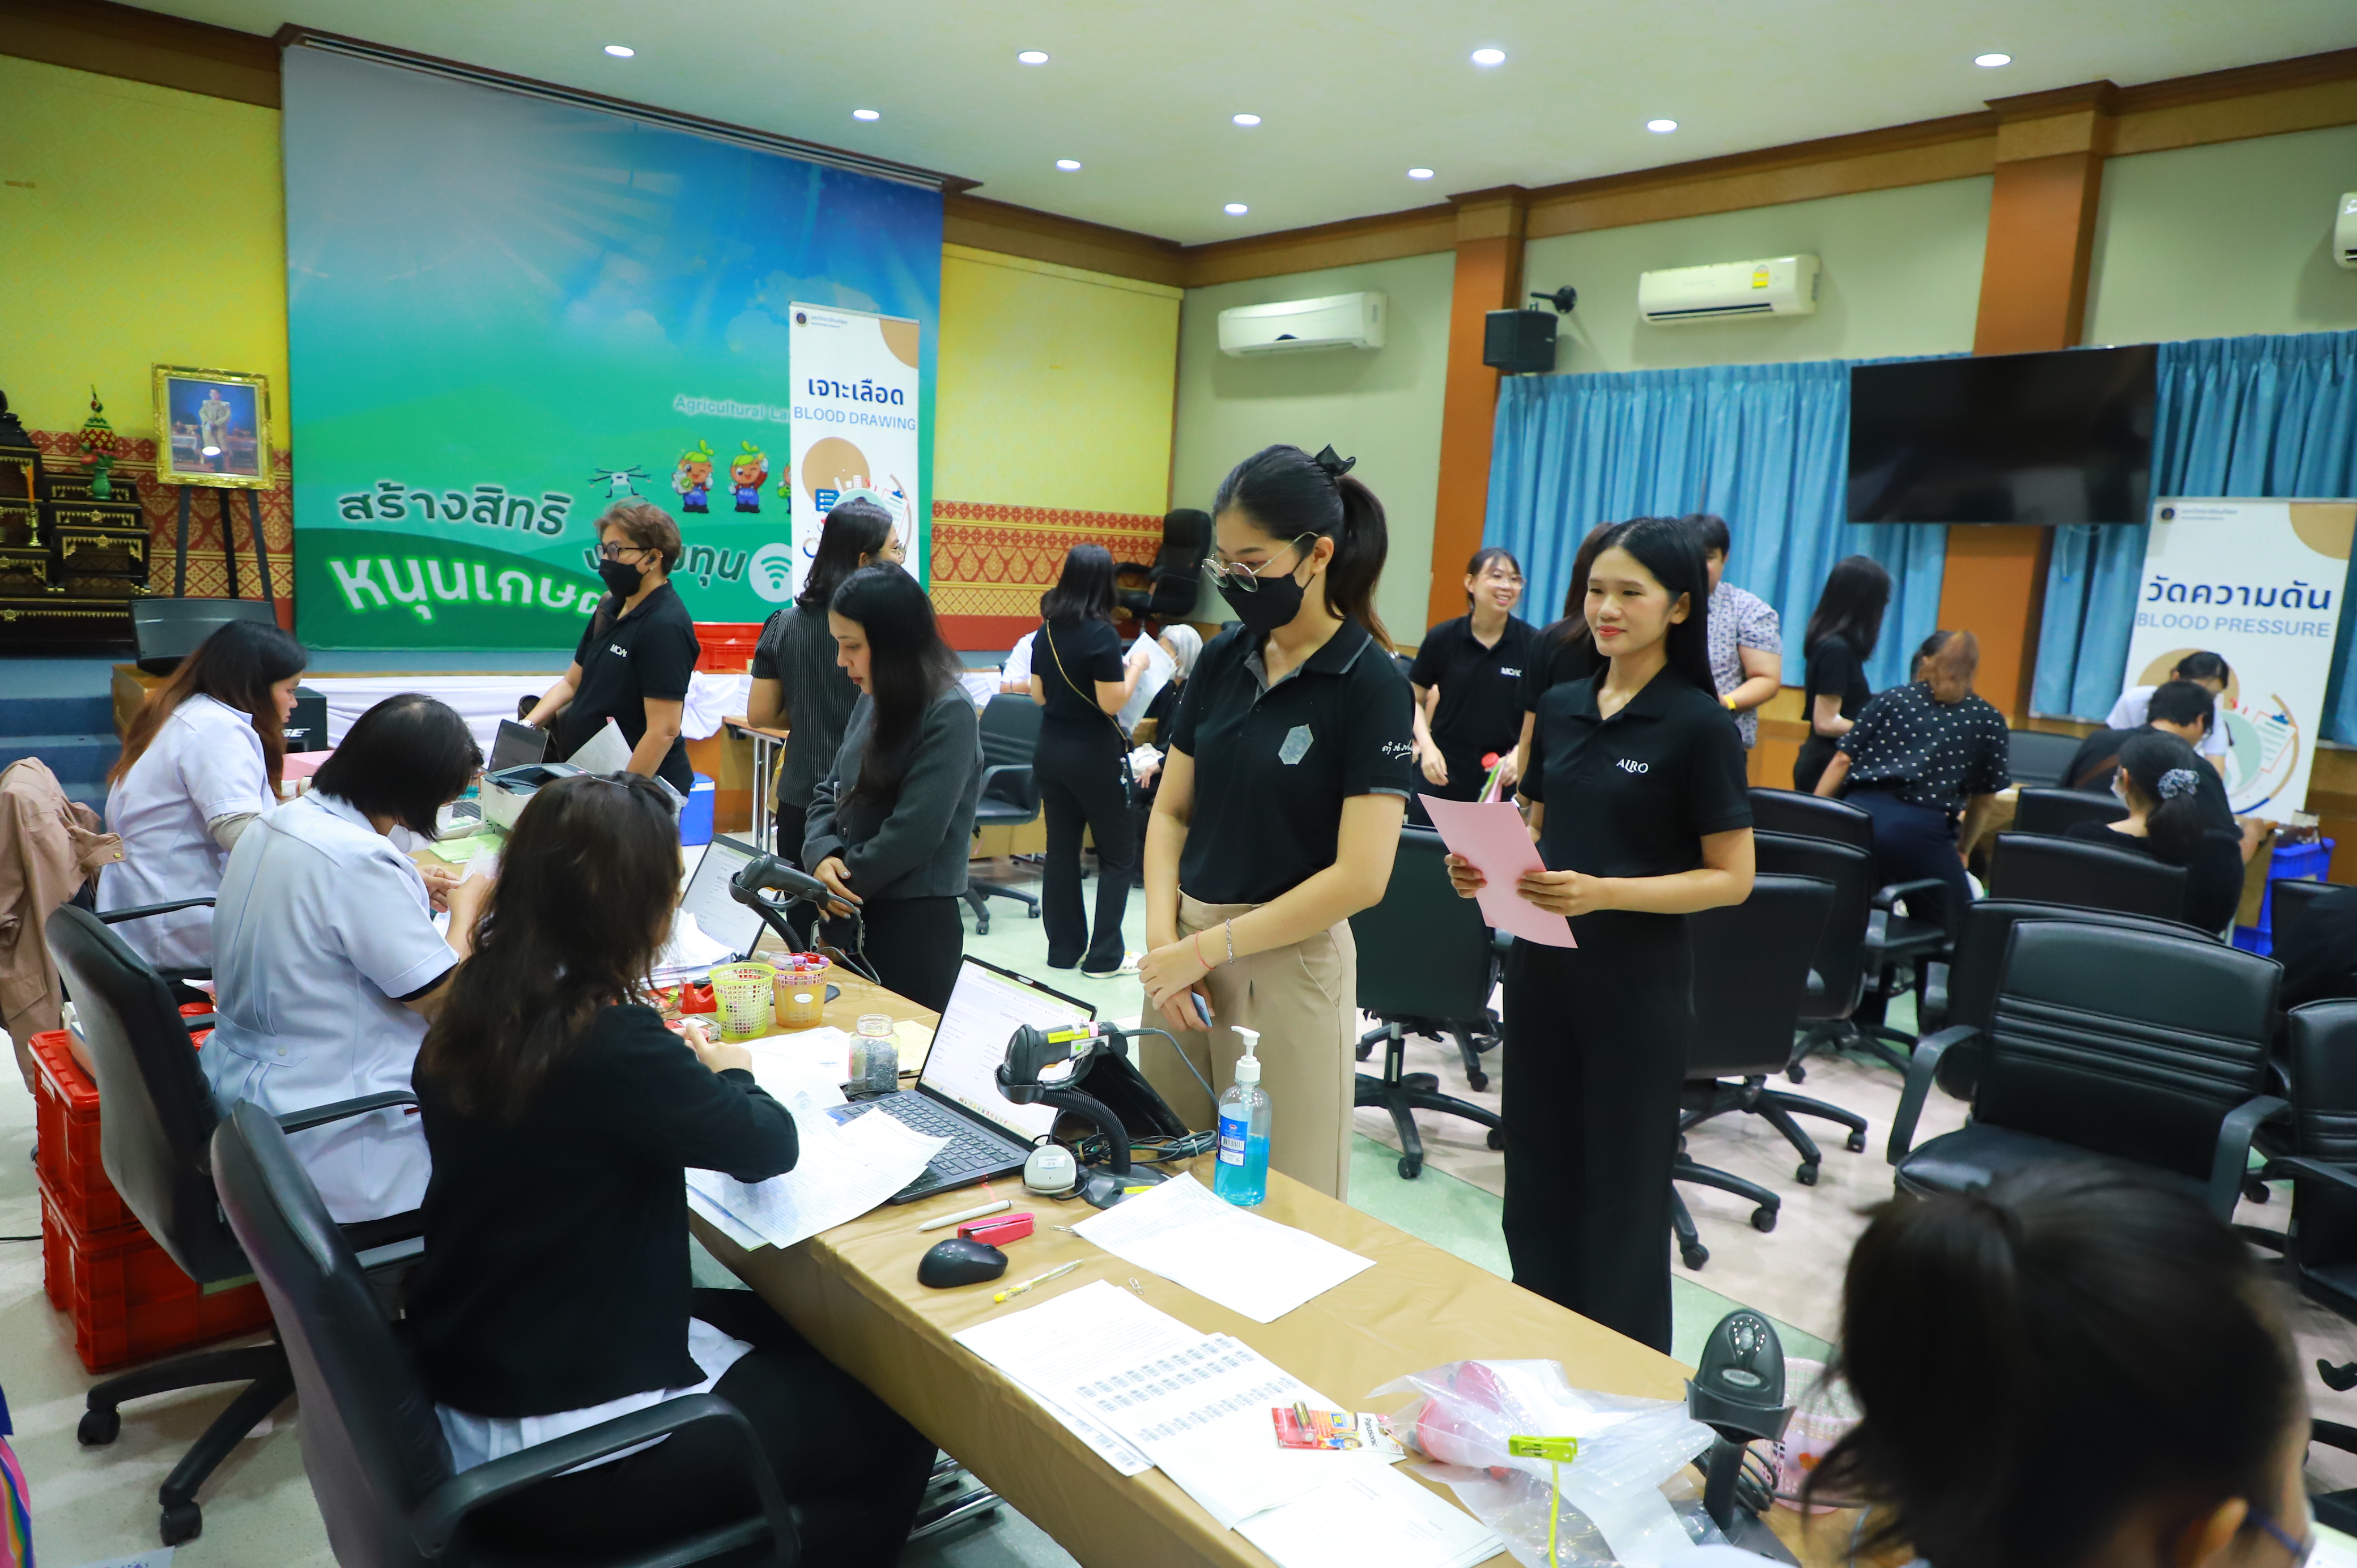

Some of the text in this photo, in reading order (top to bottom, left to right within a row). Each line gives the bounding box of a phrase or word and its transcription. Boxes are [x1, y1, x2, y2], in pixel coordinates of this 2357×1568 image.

[808, 378, 904, 406] เจาะเลือด
[675, 397, 764, 418] Agricultural
[794, 406, 916, 431] BLOOD DRAWING
[339, 482, 571, 535] สร้างสิทธิ
[2147, 574, 2332, 610] วัดความดัน
[2137, 612, 2331, 638] BLOOD PRESSURE
[1615, 757, 1649, 774] ALRO
[1000, 1010, 1013, 1020] Customer
[1333, 1415, 1342, 1424] 12
[1363, 1417, 1379, 1447] Panasonic
